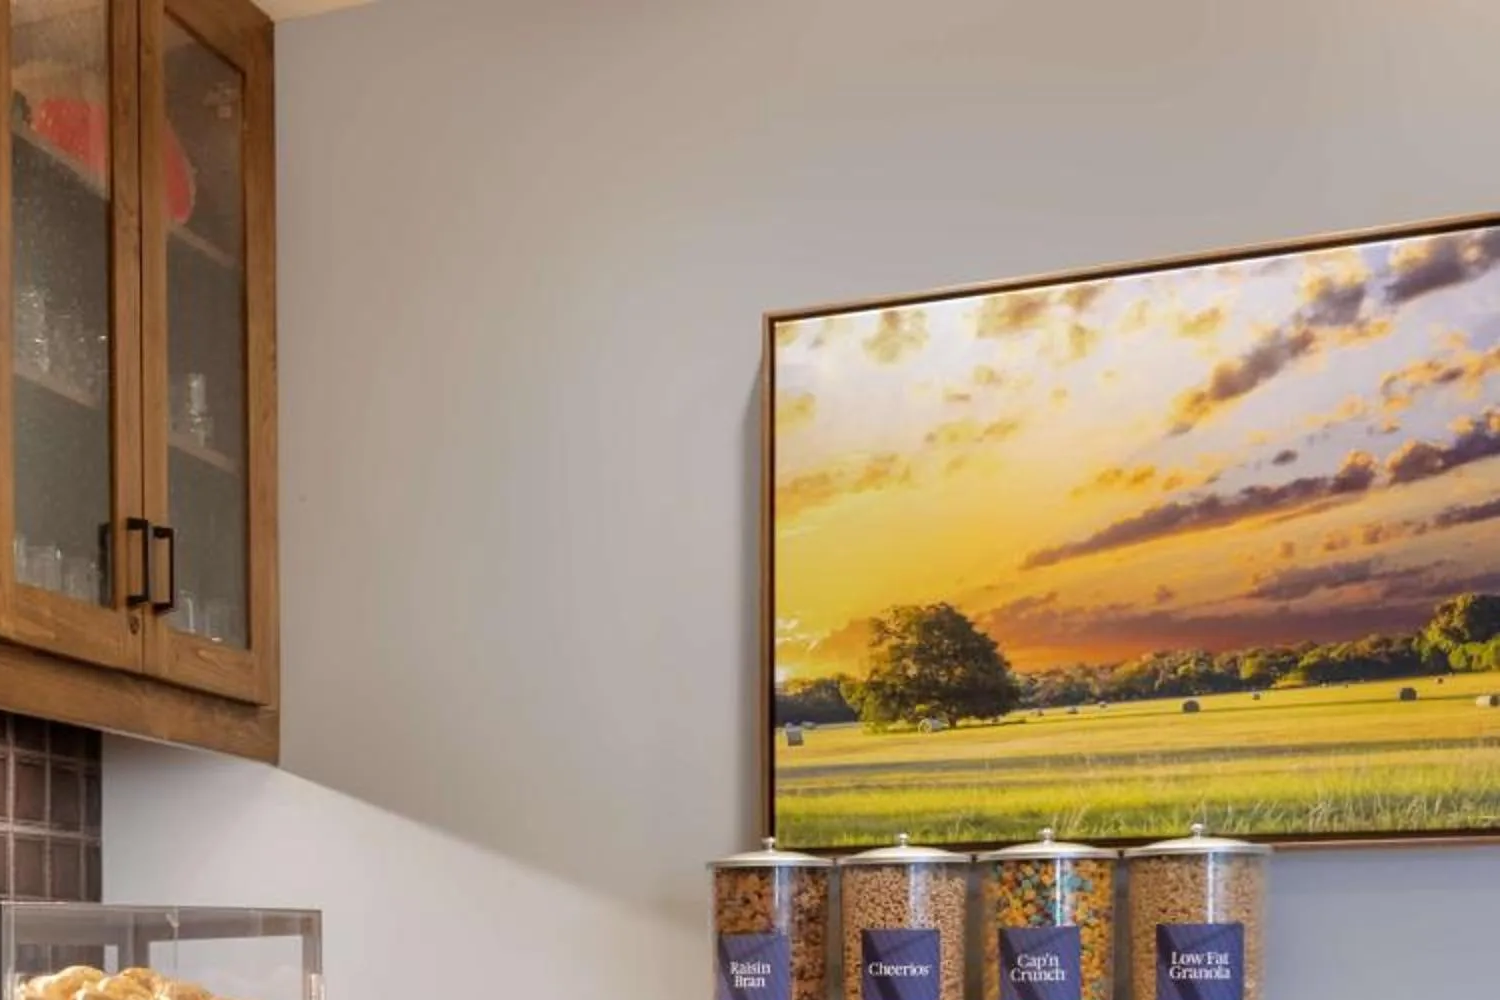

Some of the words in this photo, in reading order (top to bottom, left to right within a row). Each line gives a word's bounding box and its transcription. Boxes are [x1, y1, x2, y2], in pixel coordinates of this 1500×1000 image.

[1017, 952, 1060, 970] Cap'n
[1171, 951, 1203, 966] Low
[1207, 951, 1230, 966] Fat
[730, 961, 771, 975] Raisin
[868, 961, 930, 977] Cheerios
[1010, 968, 1065, 982] Crunch
[1169, 965, 1231, 980] Granola
[734, 975, 766, 988] Bran
